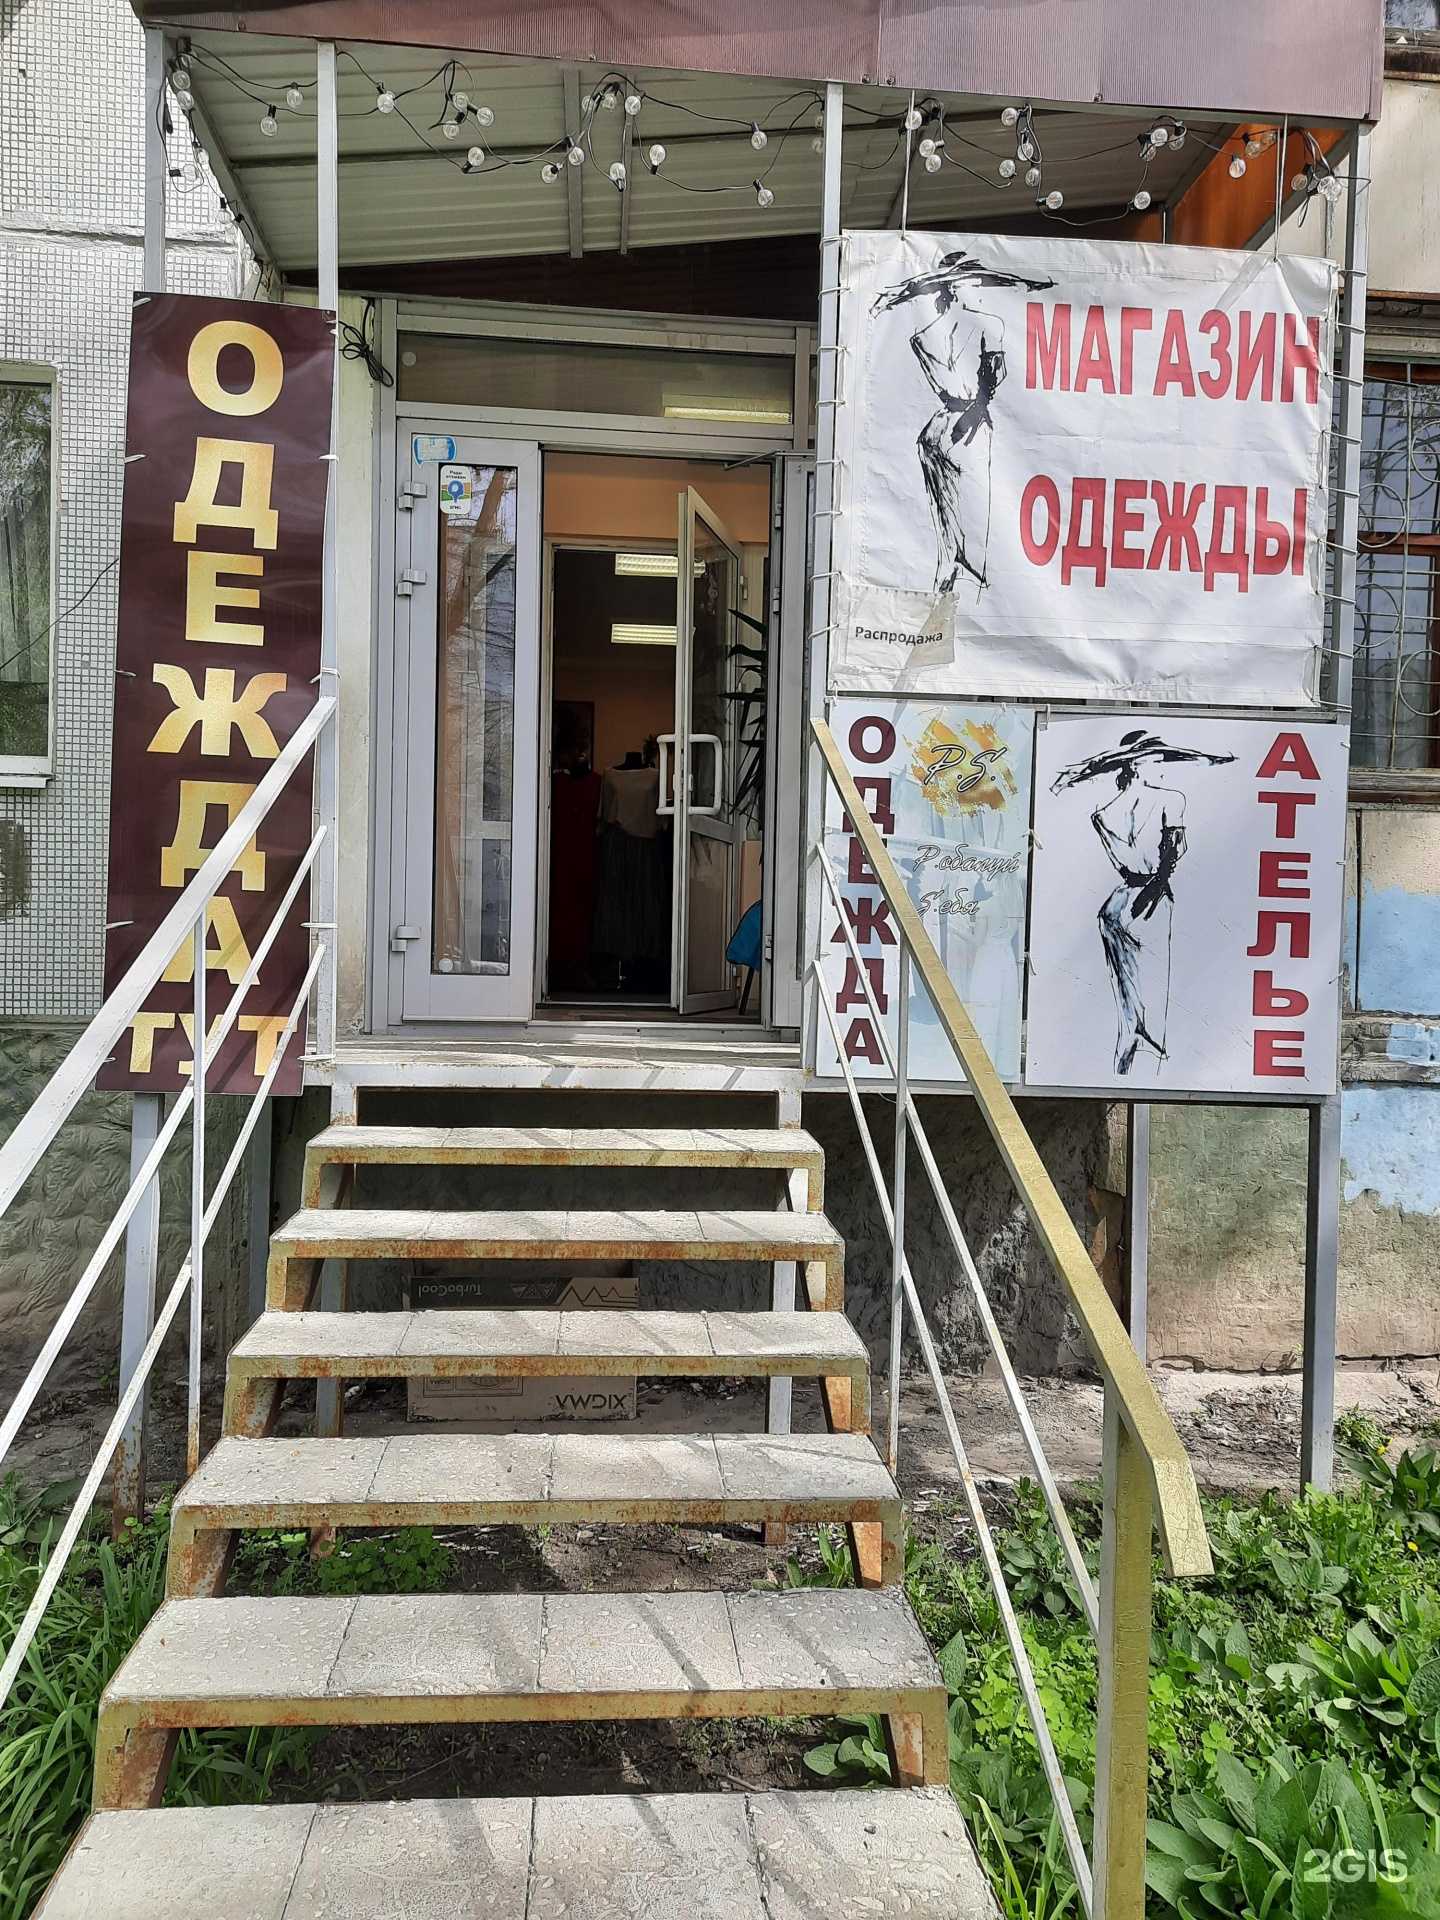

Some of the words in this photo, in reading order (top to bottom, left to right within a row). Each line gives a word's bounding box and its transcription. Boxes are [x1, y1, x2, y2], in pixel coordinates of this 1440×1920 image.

[1025, 302, 1320, 404] МАГАЗИН
[1019, 474, 1308, 593] ОДЕЖДЫ
[146, 320, 287, 986] ОДЕЖДА
[855, 626, 943, 647] Распродажа
[830, 715, 898, 1065] ОДЕЖДА
[1247, 732, 1321, 1077] АТЕЛЬЕ
[418, 1279, 482, 1297] TurboCool
